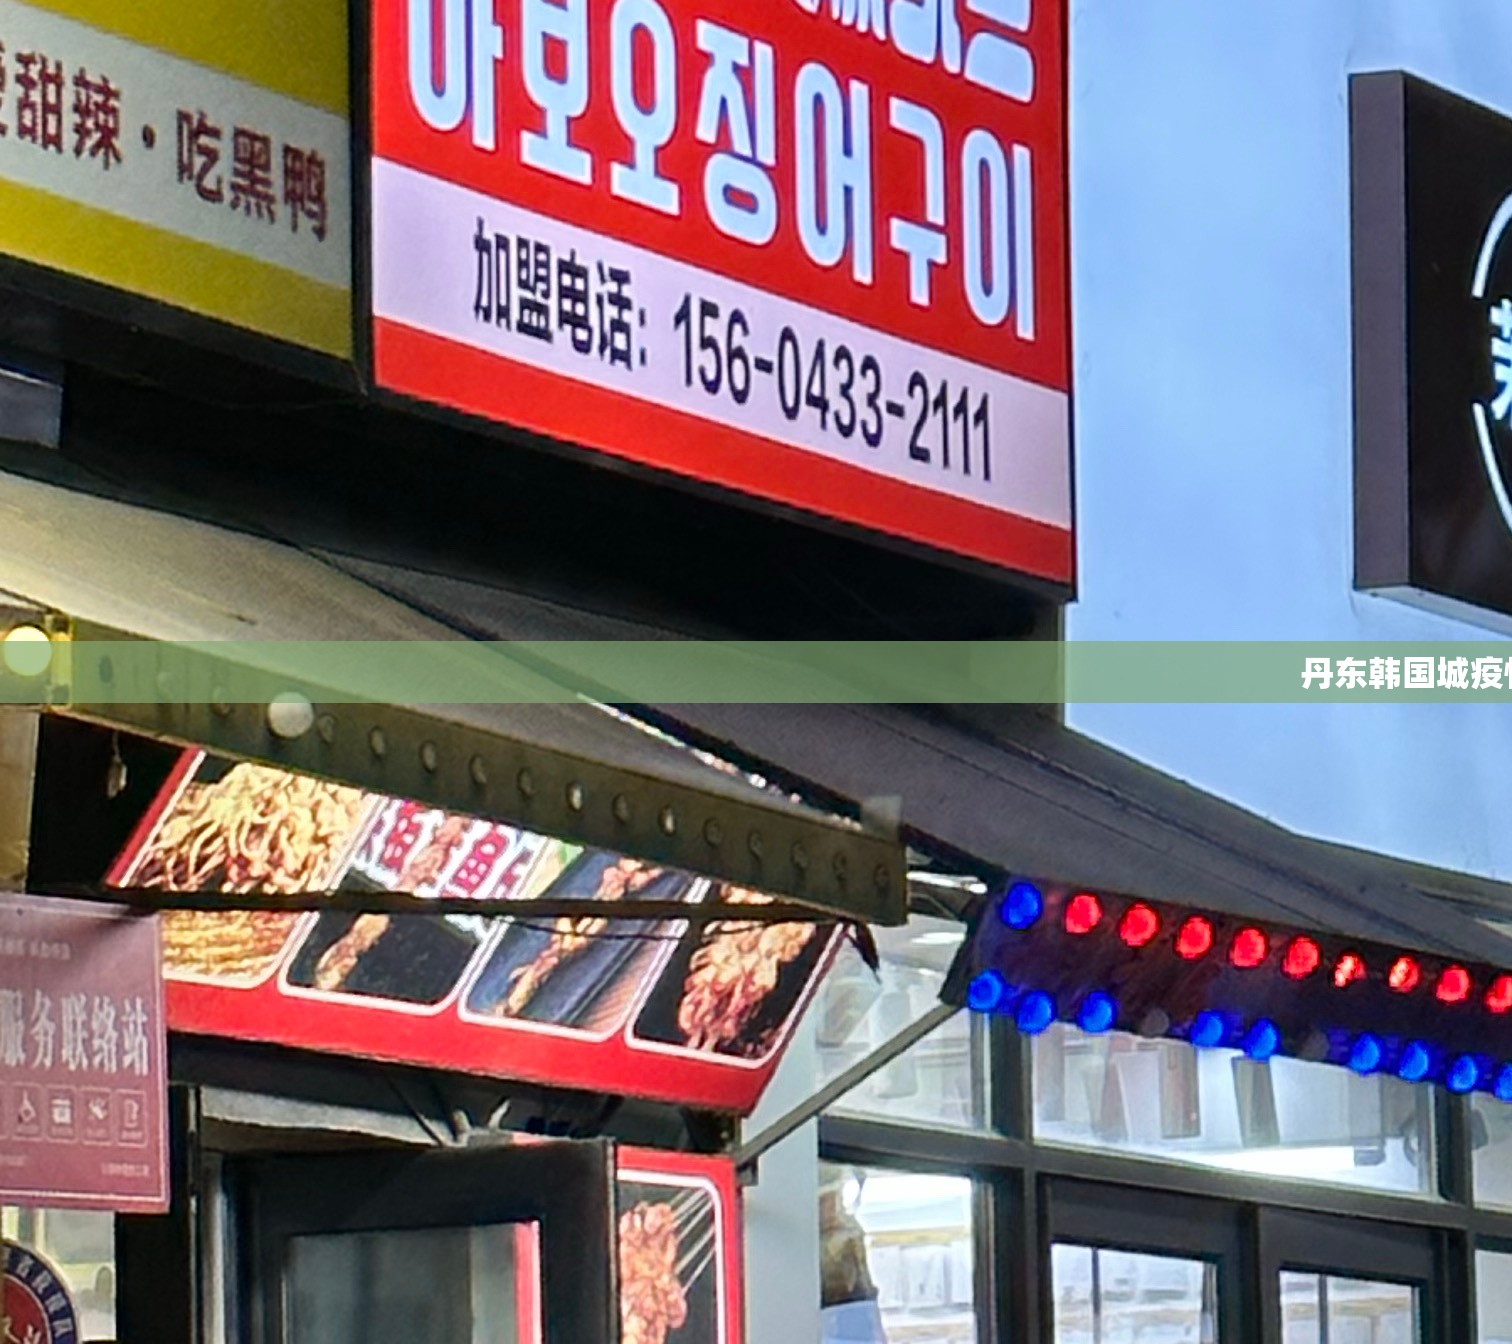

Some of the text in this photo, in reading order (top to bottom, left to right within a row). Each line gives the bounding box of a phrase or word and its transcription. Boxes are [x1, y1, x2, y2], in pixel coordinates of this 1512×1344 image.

[0, 41, 329, 242] 甜辣·吃黑鸭
[673, 291, 995, 483] 156-0433-2111
